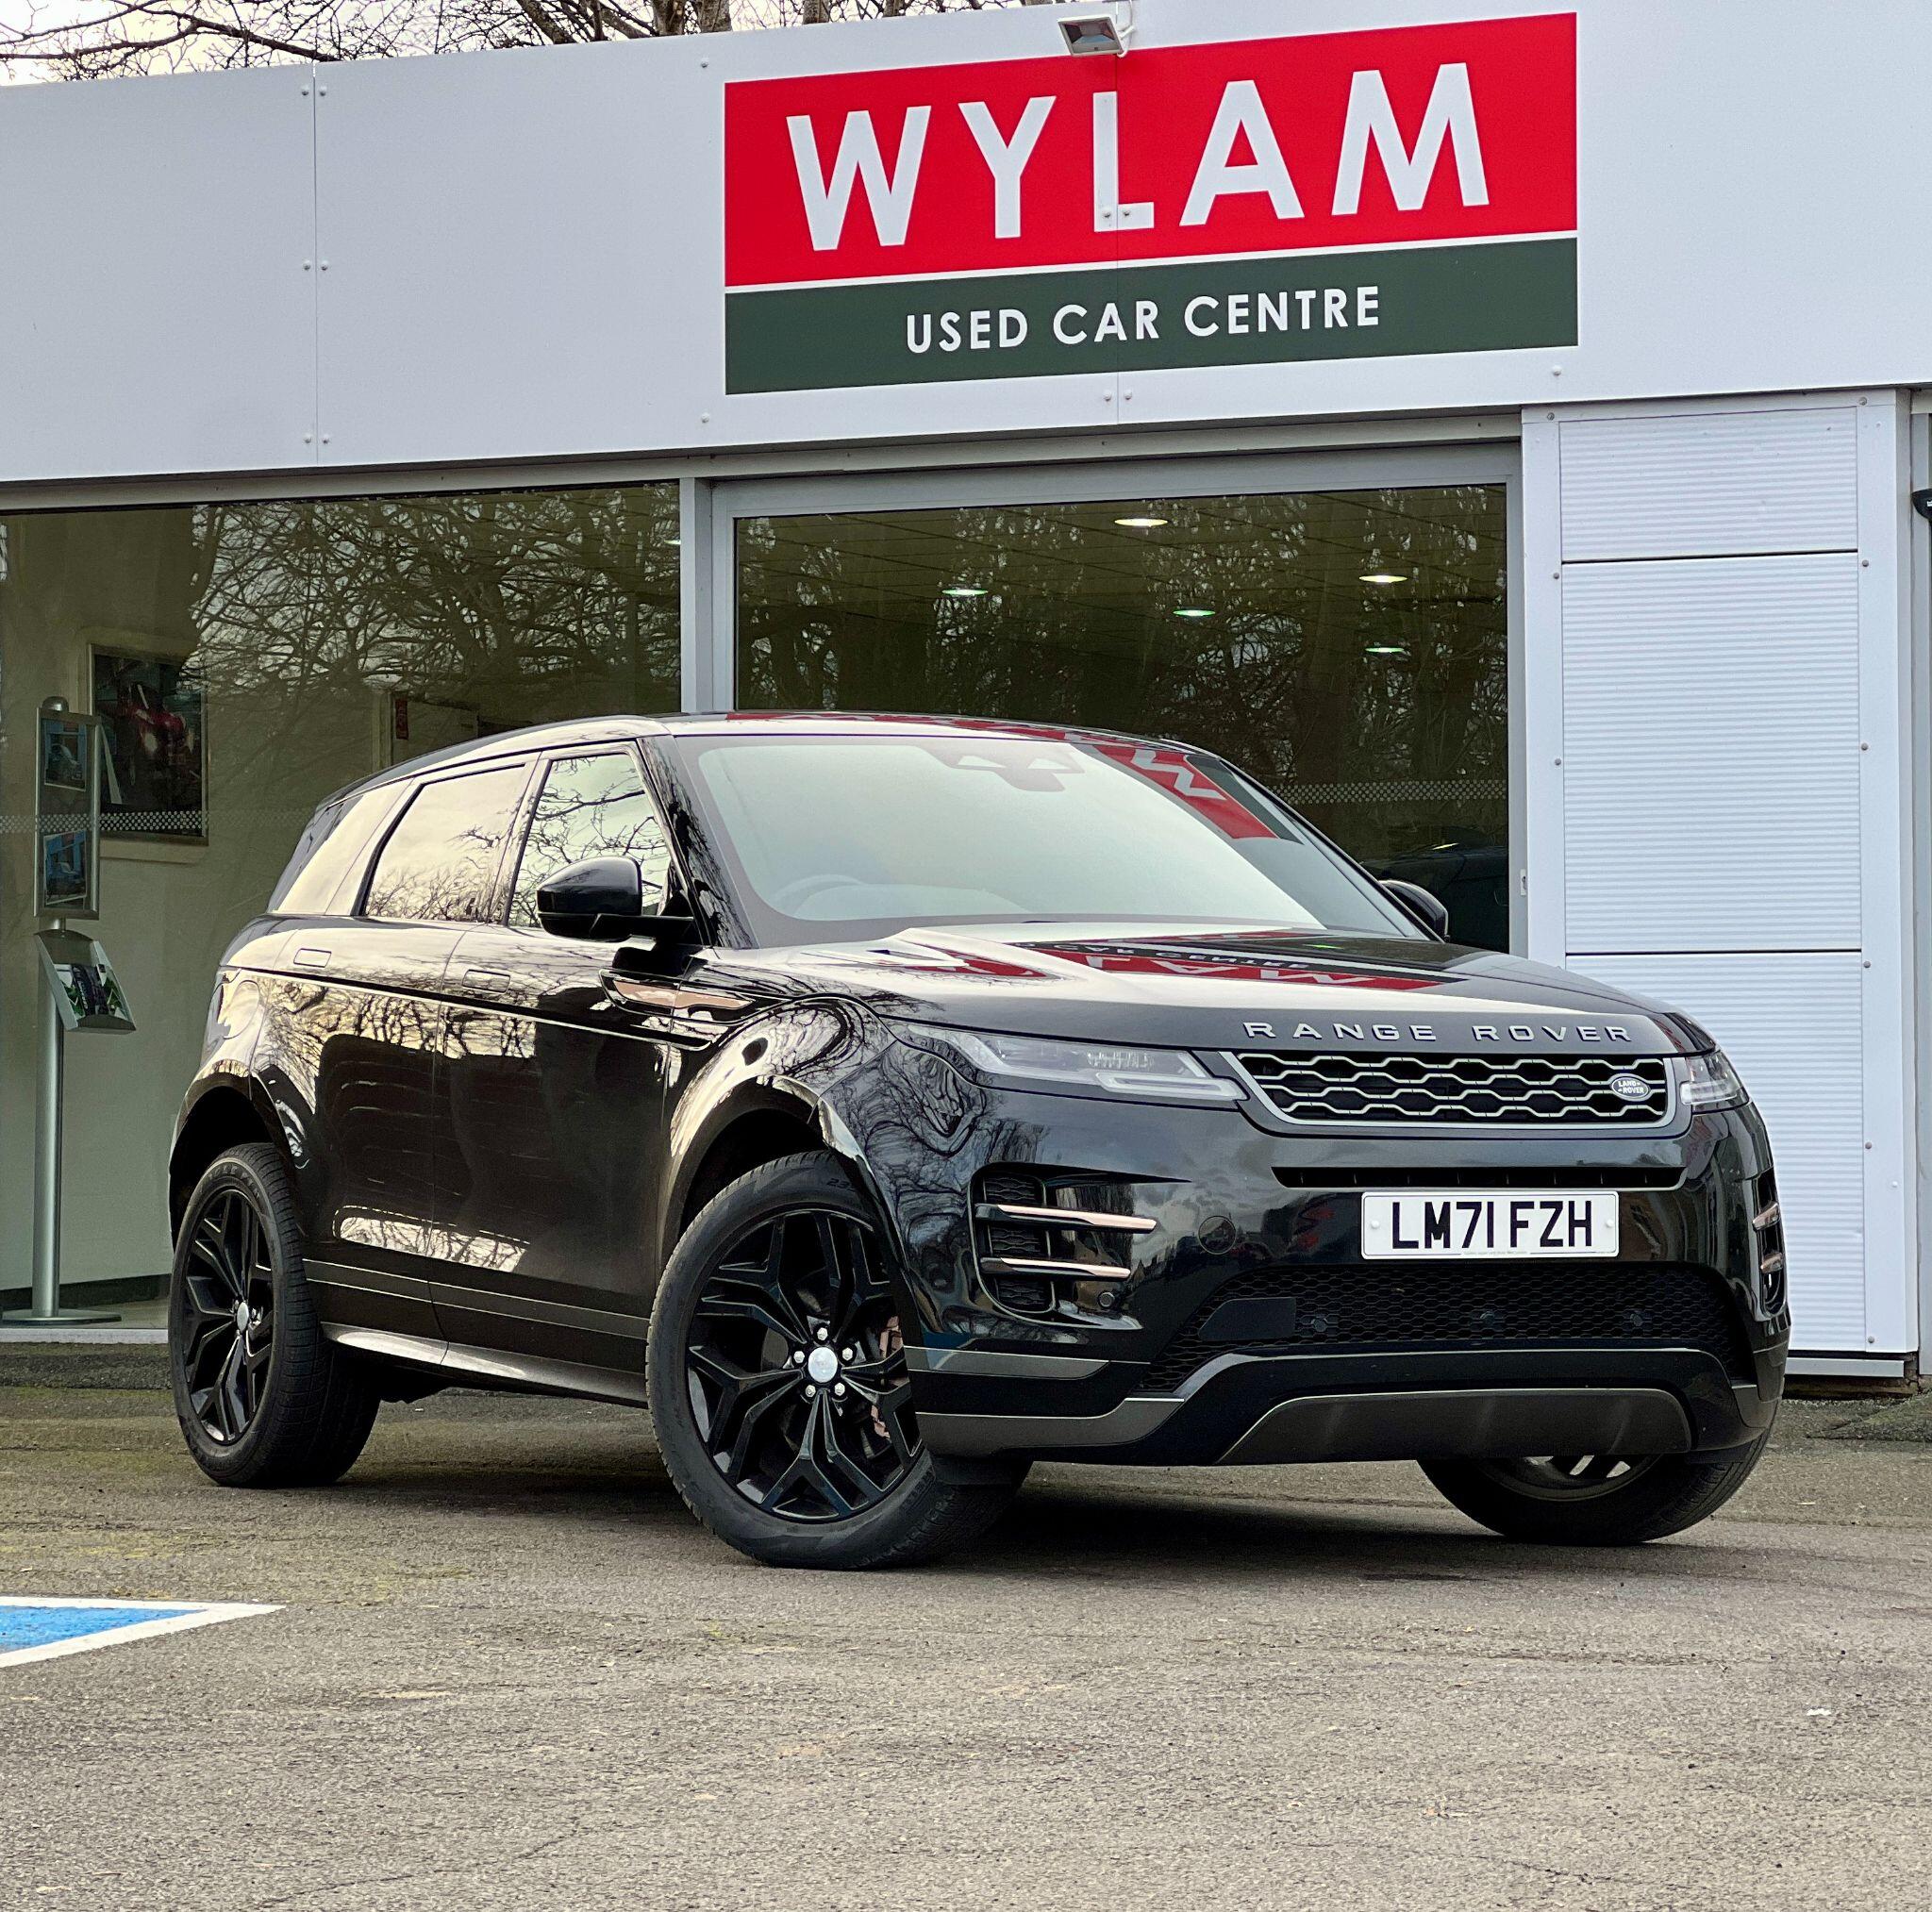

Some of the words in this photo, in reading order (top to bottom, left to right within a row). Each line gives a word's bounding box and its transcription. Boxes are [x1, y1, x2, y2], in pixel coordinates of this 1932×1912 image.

[786, 62, 1490, 251] WYLAM
[907, 308, 1028, 354] USED
[1053, 300, 1159, 345] CAR
[1184, 285, 1379, 337] CENTRE
[1242, 1022, 1437, 1041] RANGE
[1472, 1024, 1633, 1042] ROVER
[1391, 1201, 1494, 1250] LM71
[1509, 1200, 1592, 1248] FZH
